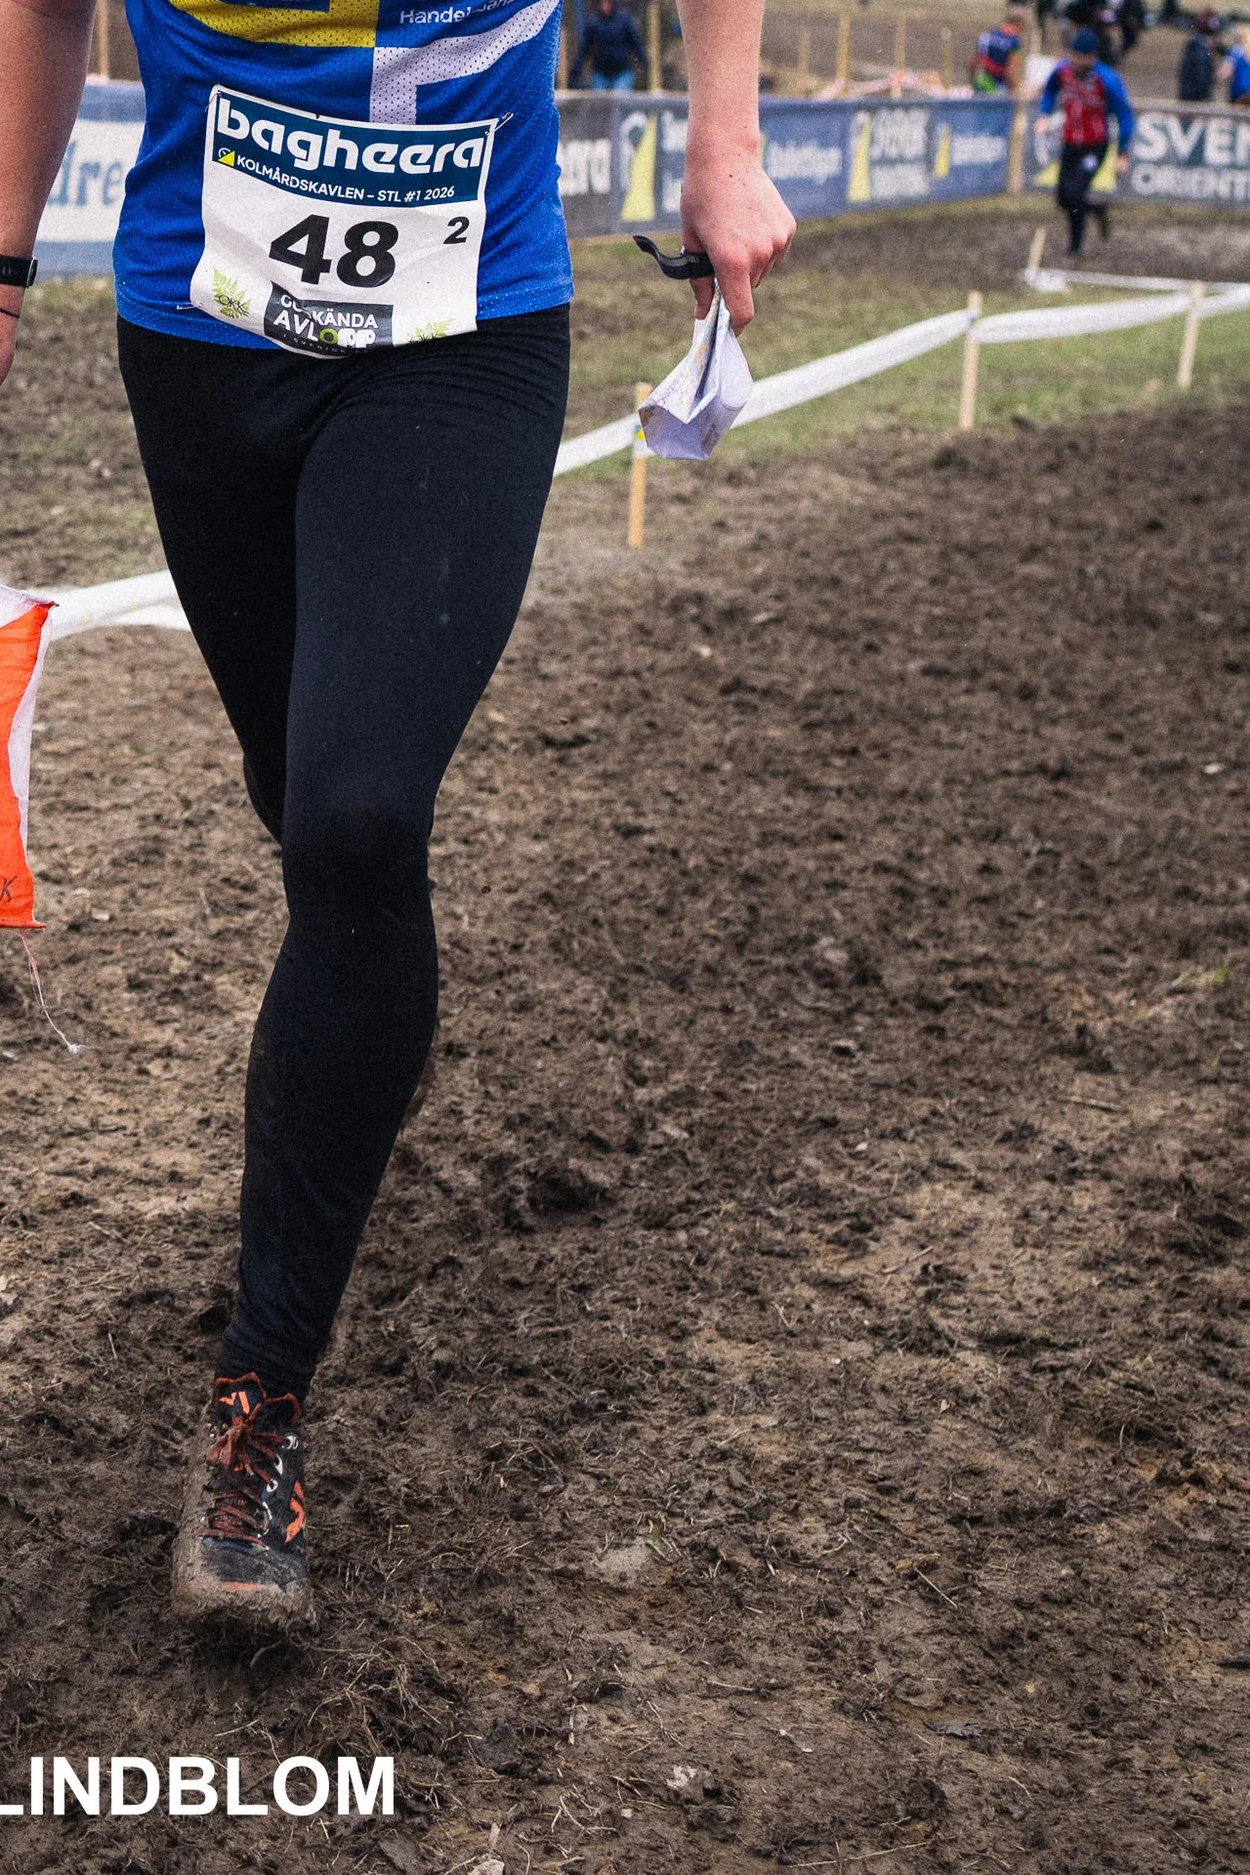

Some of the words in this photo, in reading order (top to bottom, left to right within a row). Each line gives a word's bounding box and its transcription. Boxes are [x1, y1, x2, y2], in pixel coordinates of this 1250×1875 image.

[216, 97, 484, 175] bagheera
[236, 155, 365, 201] KOLMÅRDSKAVLEN
[377, 189, 401, 202] STL
[403, 189, 421, 203] #1
[424, 186, 455, 201] 2026
[268, 214, 399, 288] 48
[443, 216, 470, 245] 2
